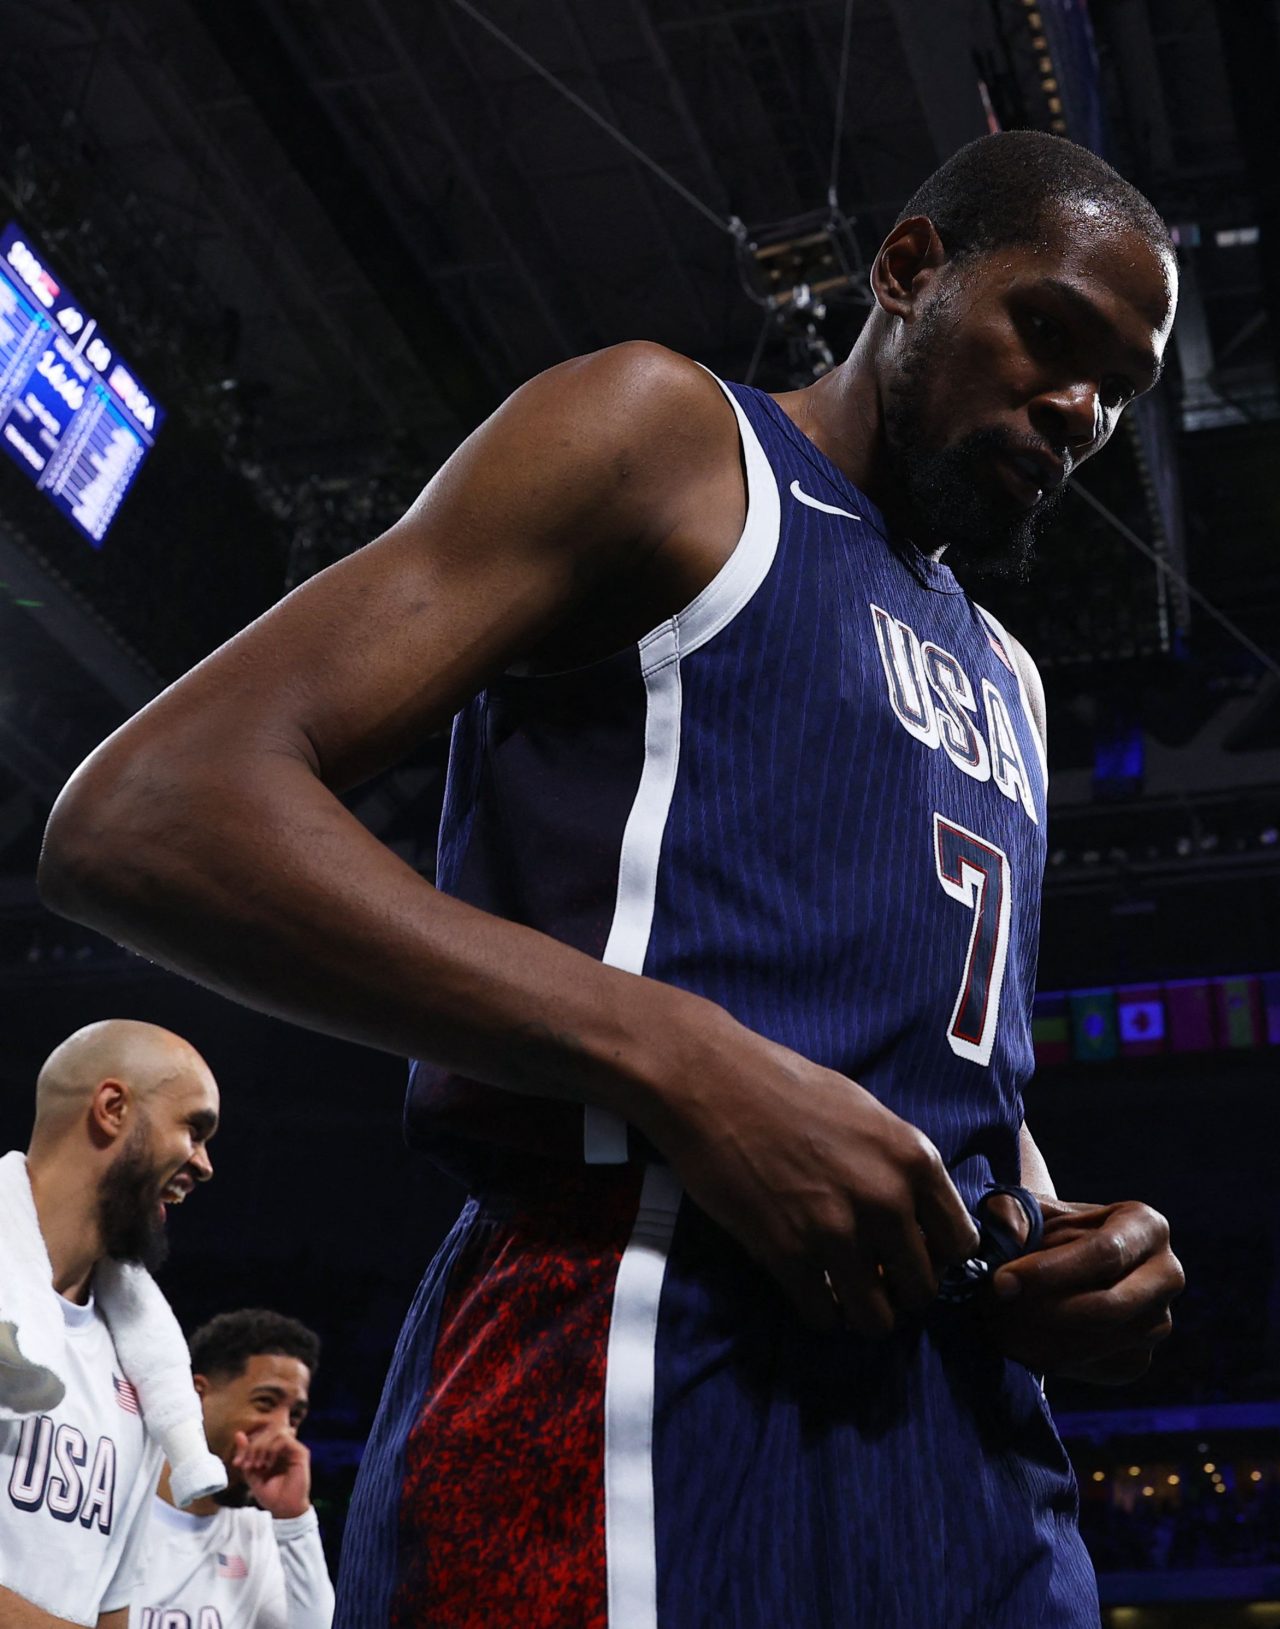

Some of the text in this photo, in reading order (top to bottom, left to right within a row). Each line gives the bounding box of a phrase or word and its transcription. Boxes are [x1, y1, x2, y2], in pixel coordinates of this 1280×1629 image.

[869, 602, 1039, 826] USA
[933, 811, 1012, 1067] 7
[8, 1414, 117, 1536] USA
